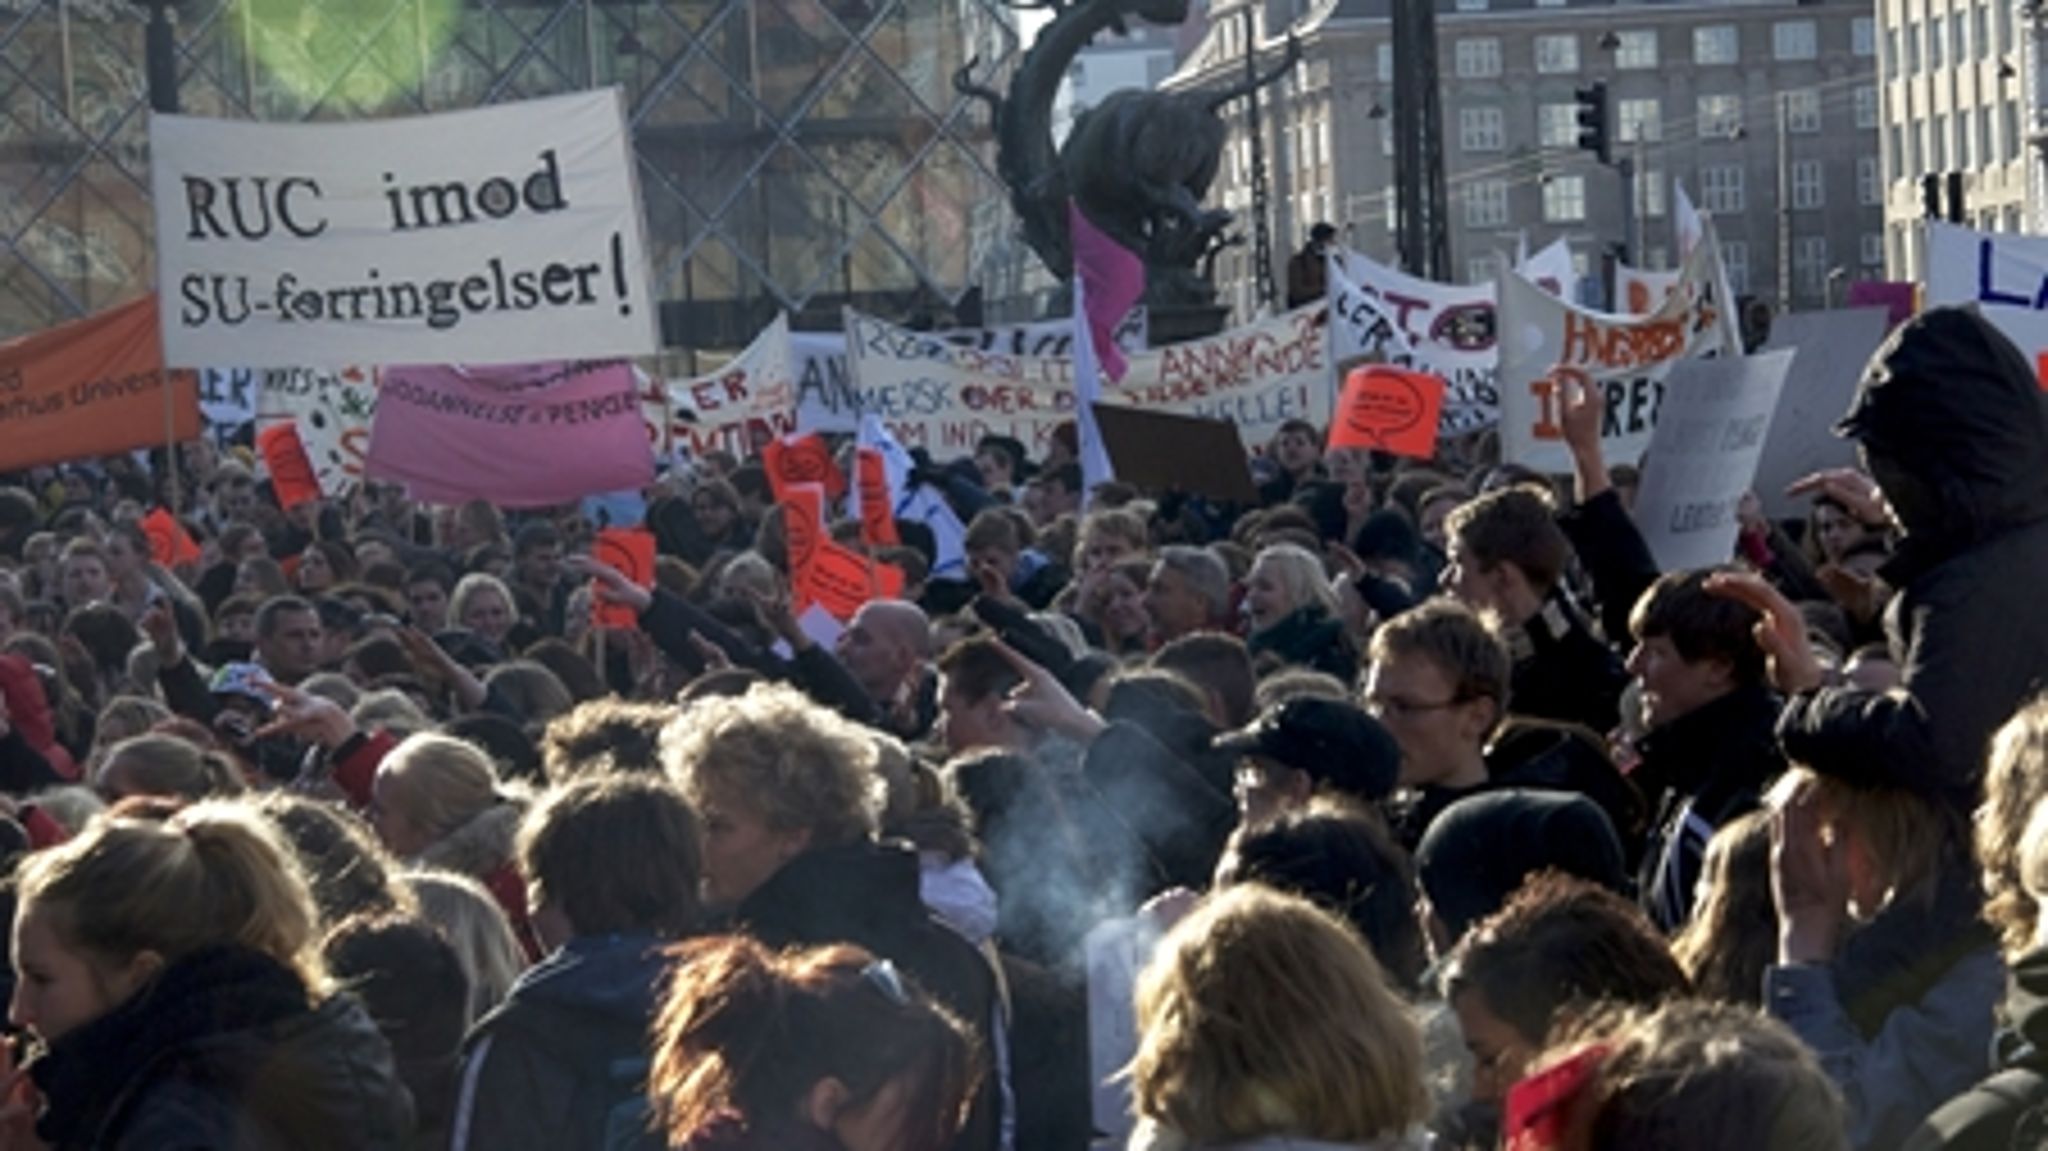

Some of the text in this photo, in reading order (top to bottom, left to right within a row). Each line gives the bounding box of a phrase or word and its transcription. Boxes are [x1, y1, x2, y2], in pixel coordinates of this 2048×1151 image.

[181, 149, 569, 241] RUC imod
[1979, 238, 2048, 310] L
